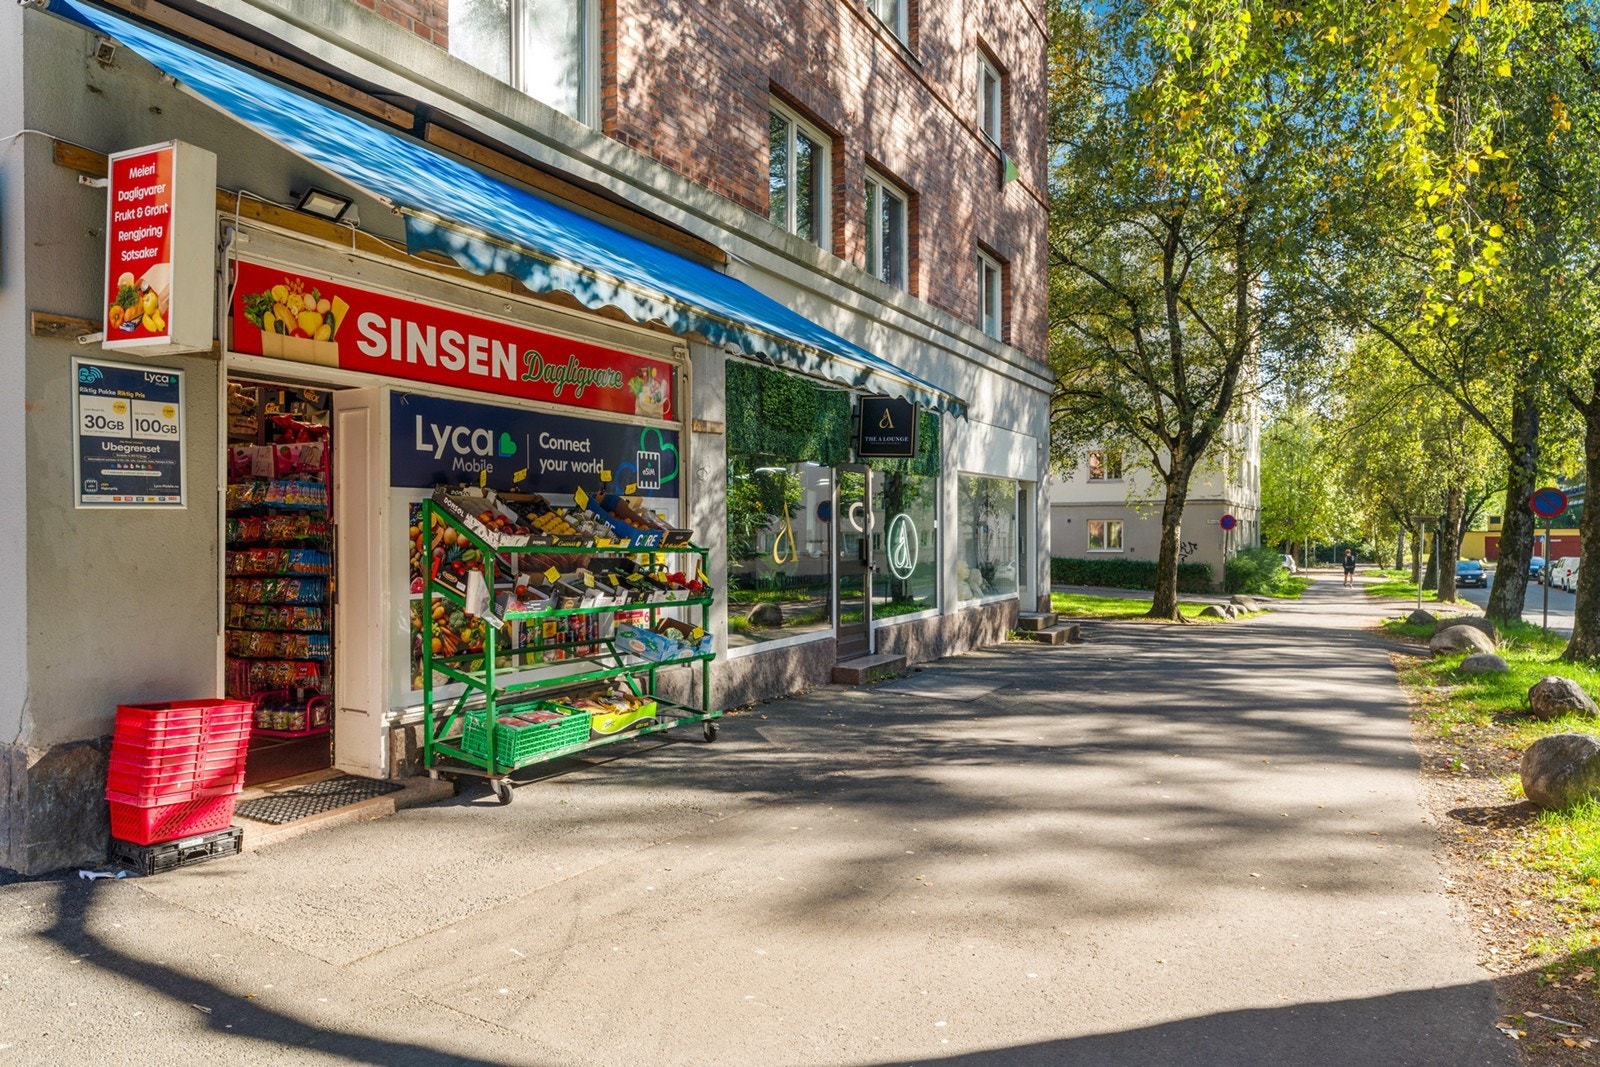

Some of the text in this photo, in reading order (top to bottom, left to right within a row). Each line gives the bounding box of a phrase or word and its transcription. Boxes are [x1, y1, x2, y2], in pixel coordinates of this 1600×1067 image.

[129, 163, 156, 179] Meieri
[118, 183, 166, 202] Dagligvarer
[114, 203, 168, 222] Frukt & Grønt
[118, 226, 163, 242] Rengjøring
[121, 246, 158, 262] Søtsaker
[356, 312, 624, 398] SINSEN Dagligvare
[144, 371, 169, 383] Lyca
[79, 386, 97, 395] Riktig
[98, 387, 117, 396] Pakke
[117, 389, 134, 398] Riktig
[84, 414, 125, 431] 30GB
[135, 418, 178, 434] 100GB
[416, 414, 494, 460] Lyca
[539, 432, 591, 453] Connect
[101, 441, 161, 453] Ubegrenset
[452, 457, 494, 474] Mobile
[539, 457, 604, 474] your world
[642, 467, 656, 476] eSIM
